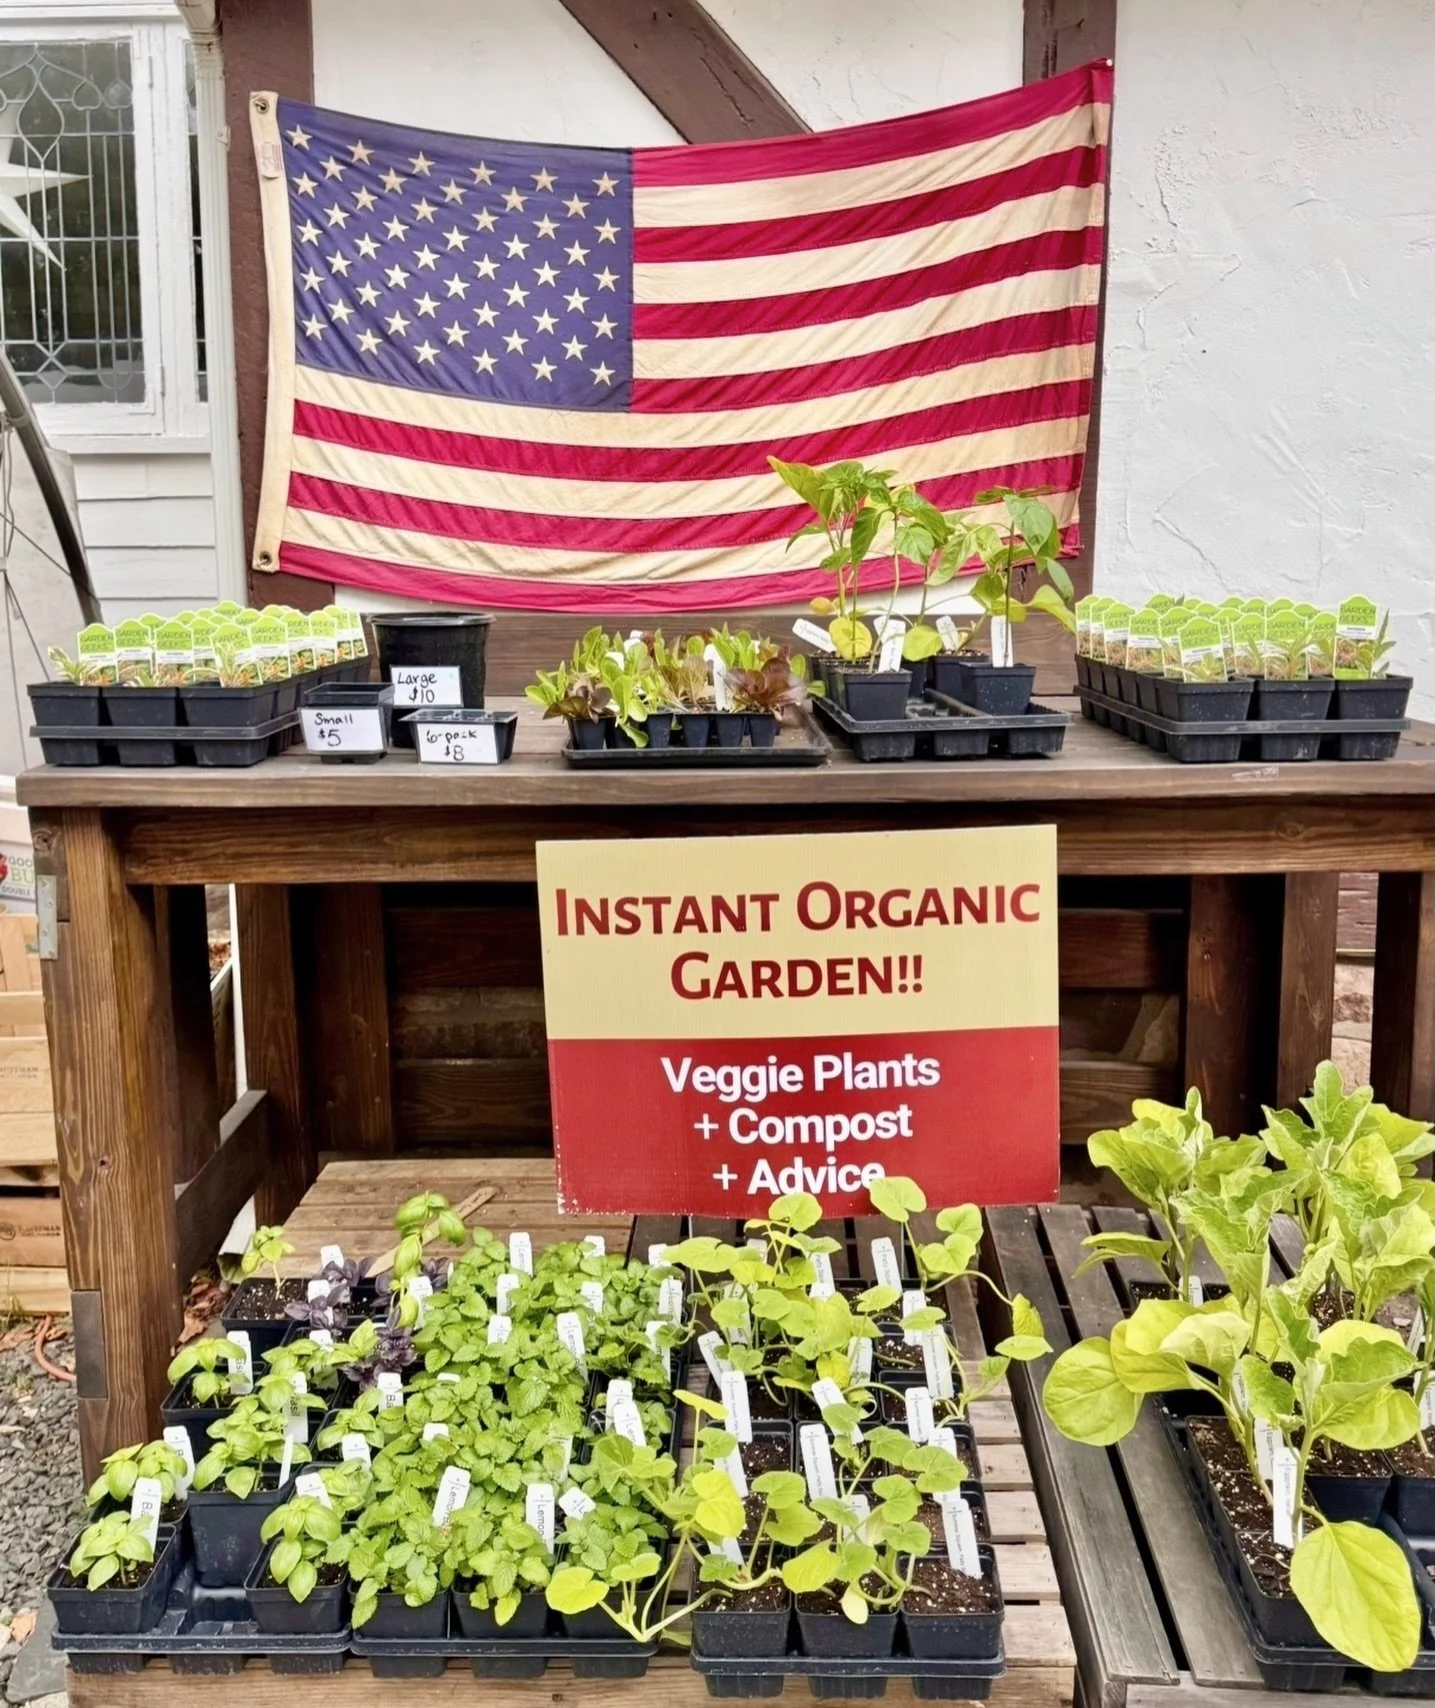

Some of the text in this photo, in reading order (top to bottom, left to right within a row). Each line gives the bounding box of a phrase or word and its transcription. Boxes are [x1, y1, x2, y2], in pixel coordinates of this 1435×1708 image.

[397, 672, 437, 689] Large
[409, 687, 436, 704] $10
[314, 712, 354, 726] Small
[319, 728, 343, 747] $5
[444, 744, 465, 762] $8
[555, 881, 1041, 937] INSTANT ORGANIC
[670, 951, 924, 1000] GARDEN!!
[660, 1051, 941, 1103] Veggie Plants
[694, 1102, 913, 1151] + Compost
[713, 1156, 885, 1196] + Advice
